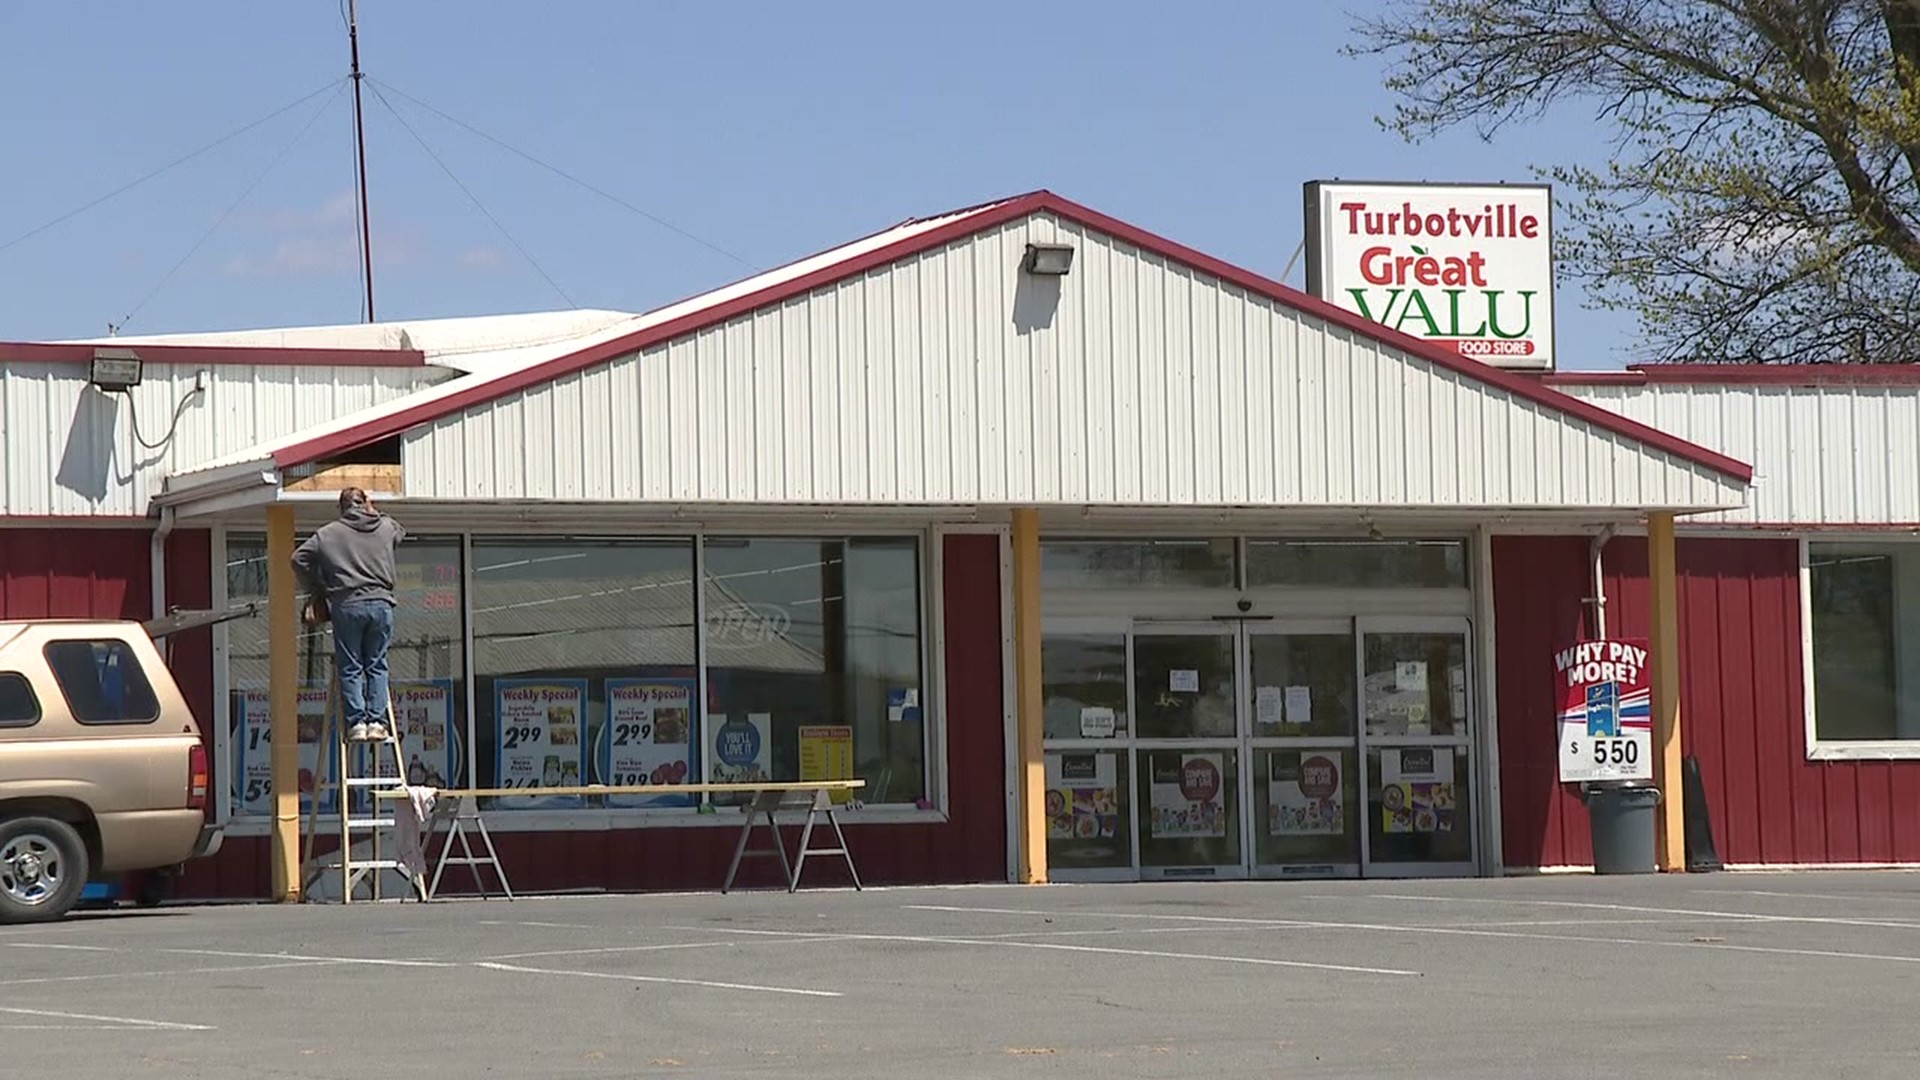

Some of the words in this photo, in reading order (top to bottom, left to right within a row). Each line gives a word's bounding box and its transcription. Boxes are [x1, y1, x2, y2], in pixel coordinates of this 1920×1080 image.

[1340, 202, 1539, 239] Turbotville
[1359, 245, 1488, 287] Great
[1345, 288, 1538, 339] VALU
[1458, 340, 1491, 354] FOOD
[1493, 341, 1527, 355] STORE
[1554, 641, 1606, 672] WHY
[1609, 641, 1647, 669] PAY
[1567, 661, 1638, 687] MORE?
[296, 690, 328, 704] pecial
[406, 688, 444, 703] Special
[503, 688, 540, 703] Weekly
[541, 688, 578, 703] Special
[612, 688, 649, 703] Weekly
[651, 688, 687, 702] Special
[724, 743, 743, 756] LOVE
